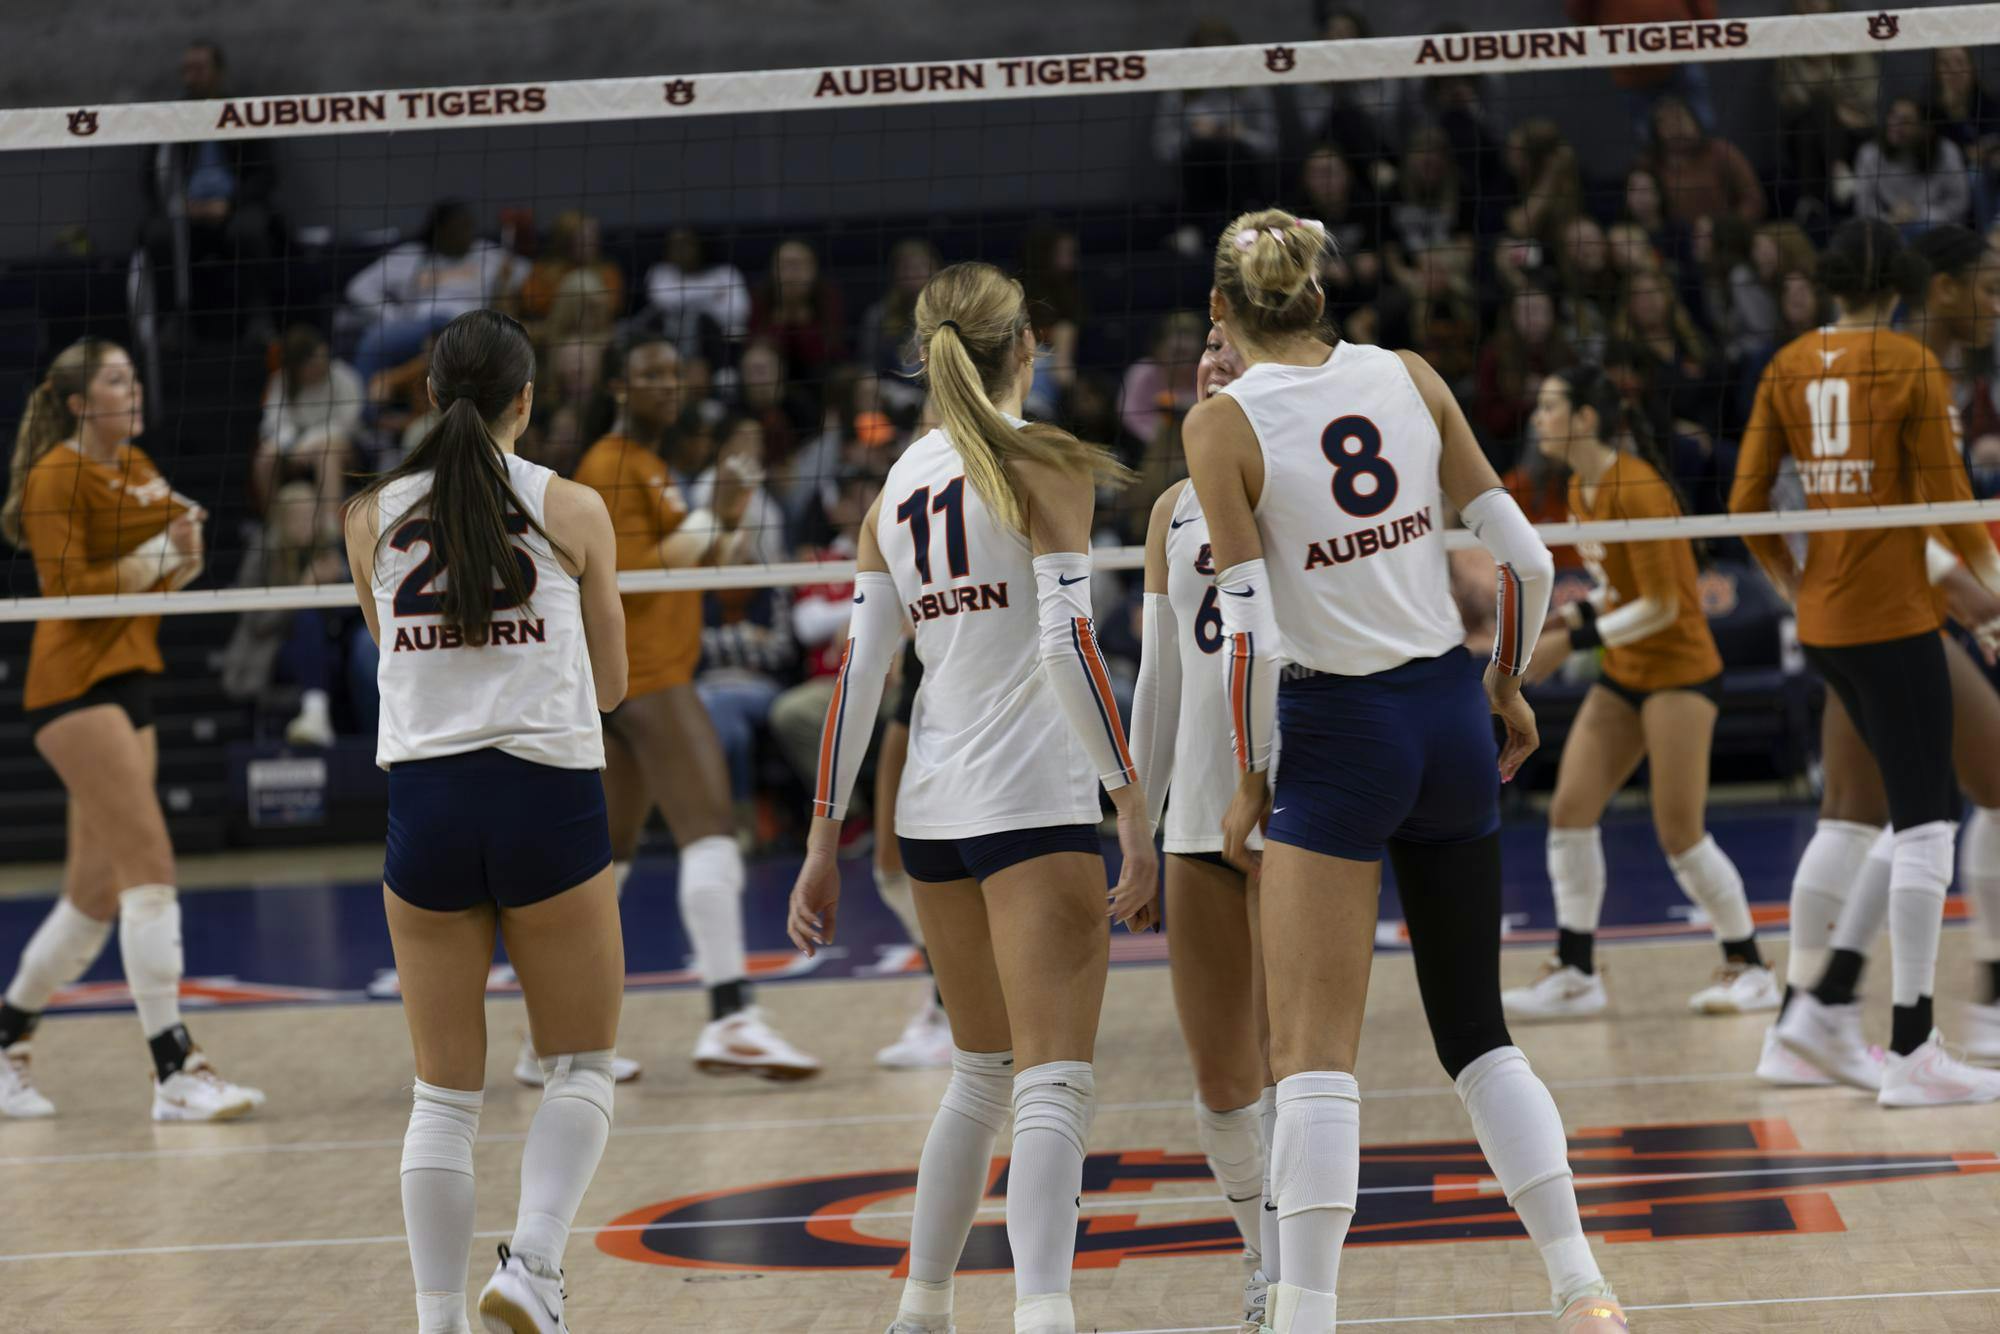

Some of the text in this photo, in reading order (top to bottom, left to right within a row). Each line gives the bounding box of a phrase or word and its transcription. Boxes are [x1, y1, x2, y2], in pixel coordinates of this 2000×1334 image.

[814, 55, 1146, 98] AUBURN TIGERS
[1415, 22, 1749, 65] AUBURN TIGERS
[216, 87, 547, 129] AUBURN TIGERS
[1805, 378, 1850, 457] 10
[1320, 414, 1399, 518] 8
[897, 474, 970, 586] 11
[1304, 506, 1433, 571] AUBURN
[1194, 585, 1225, 654] 6
